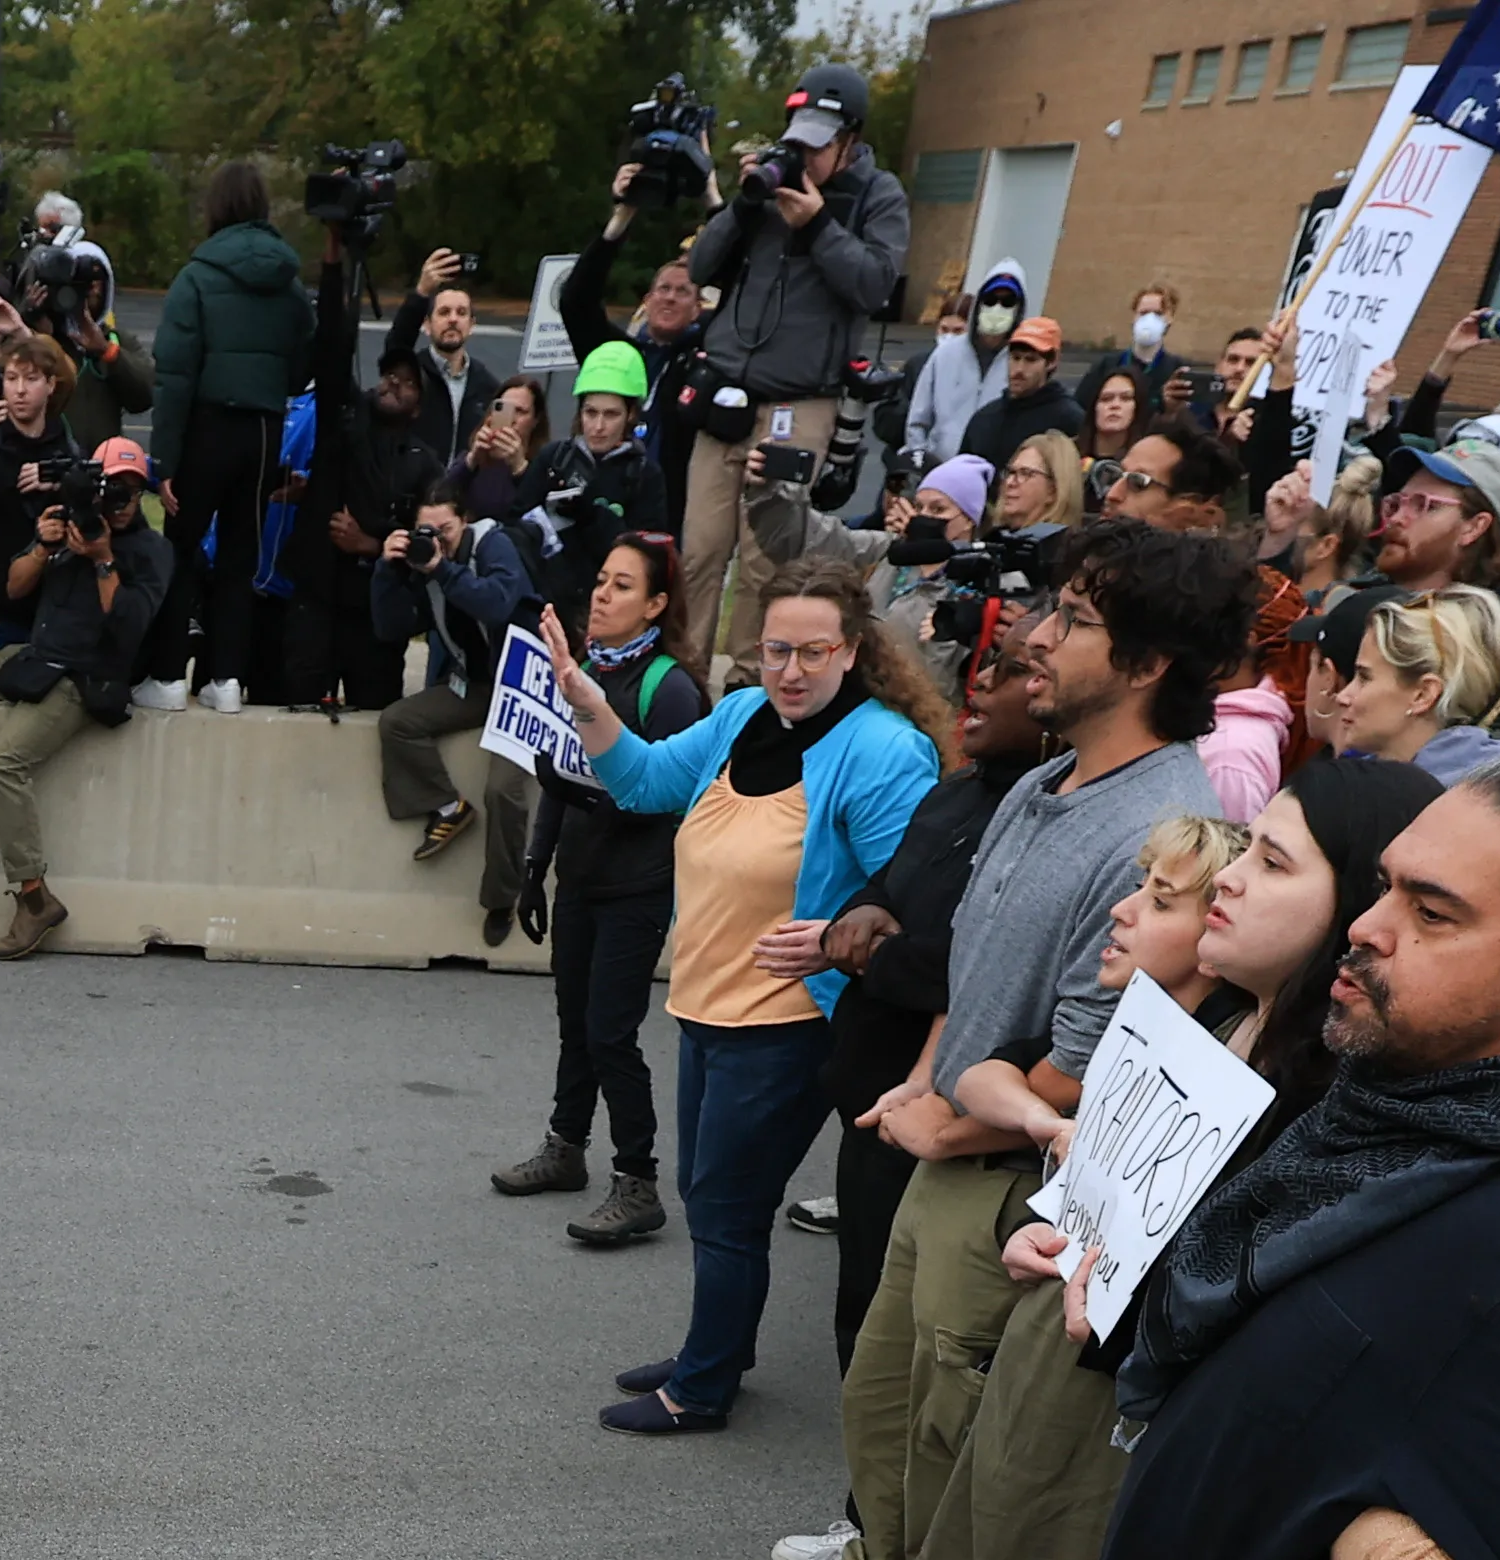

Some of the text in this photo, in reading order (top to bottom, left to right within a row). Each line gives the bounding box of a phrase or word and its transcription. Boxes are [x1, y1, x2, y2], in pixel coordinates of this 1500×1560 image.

[1382, 143, 1462, 204] OUT
[1327, 290, 1388, 325] TO THE
[520, 650, 553, 703] ICE
